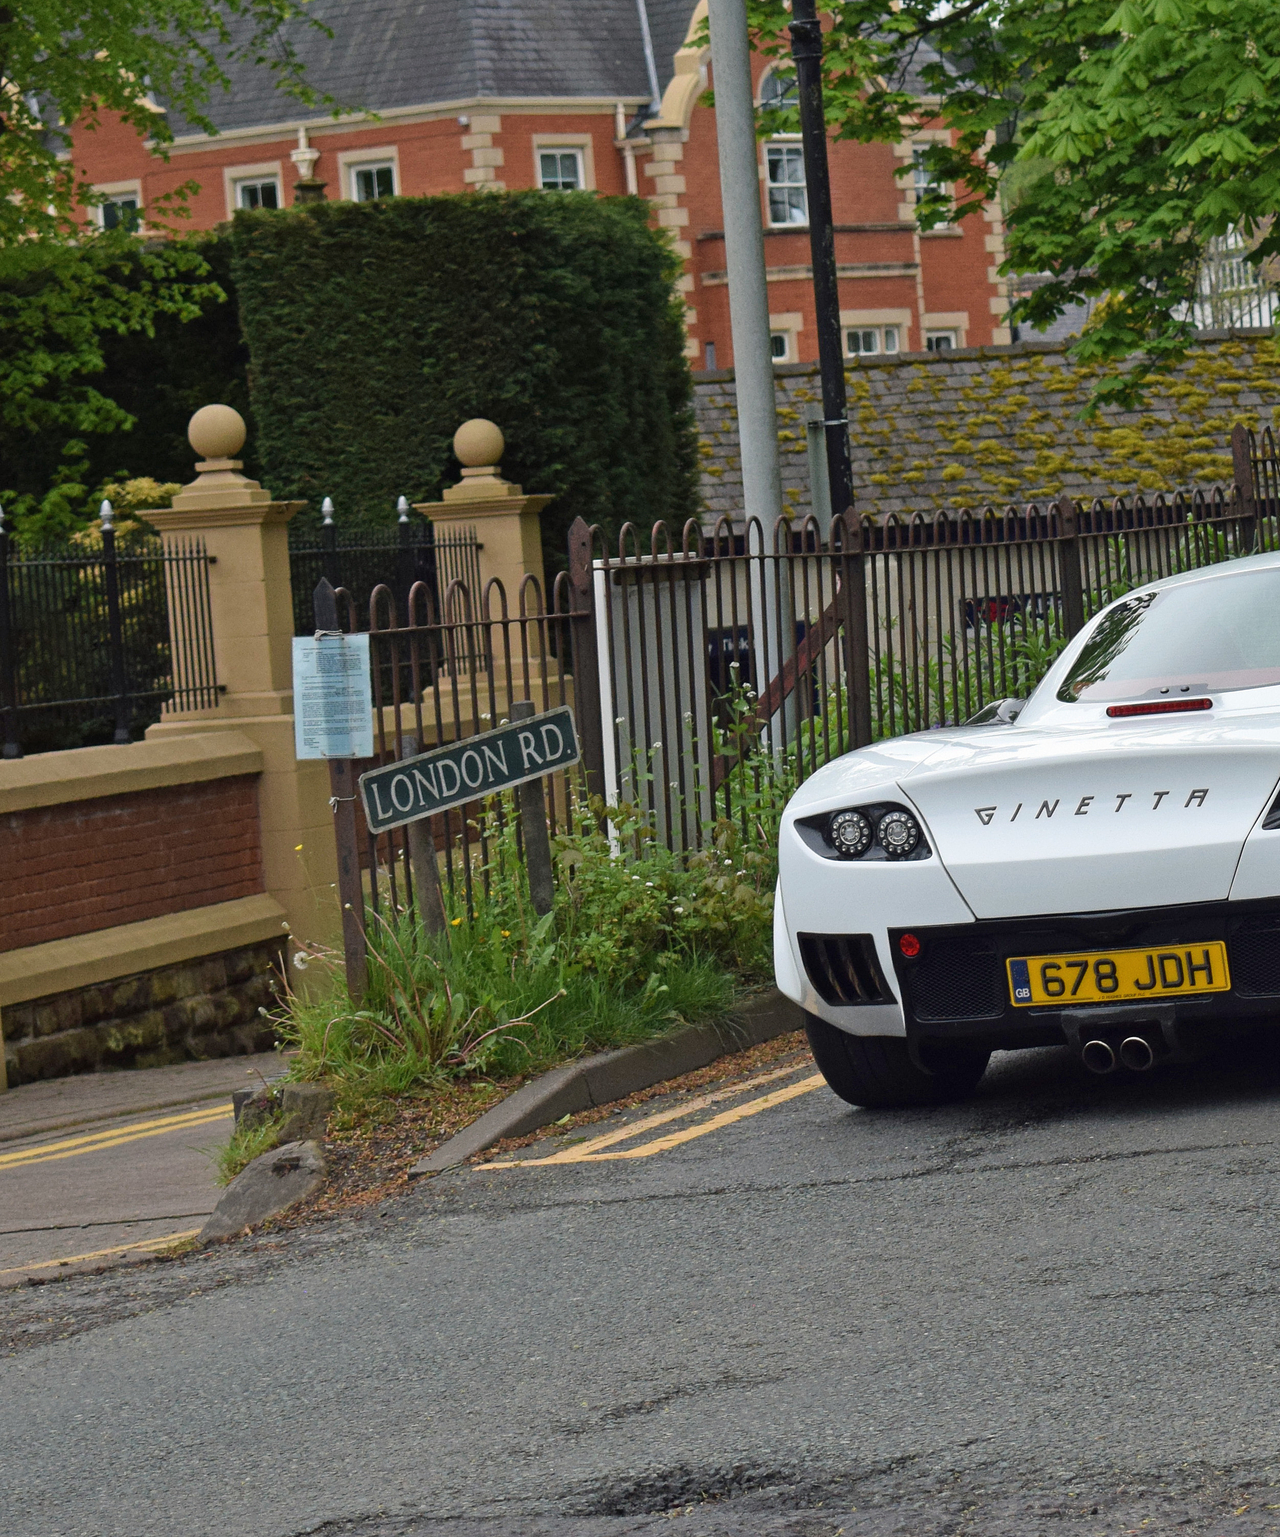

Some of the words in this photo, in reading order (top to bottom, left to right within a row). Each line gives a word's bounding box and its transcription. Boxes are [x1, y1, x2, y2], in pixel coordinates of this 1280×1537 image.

[371, 741, 509, 820] LONDON
[518, 724, 571, 769] RD.
[974, 788, 1209, 826] GINETTA
[1015, 988, 1031, 998] GB
[1041, 958, 1119, 997] 678
[1133, 949, 1214, 991] JDH
